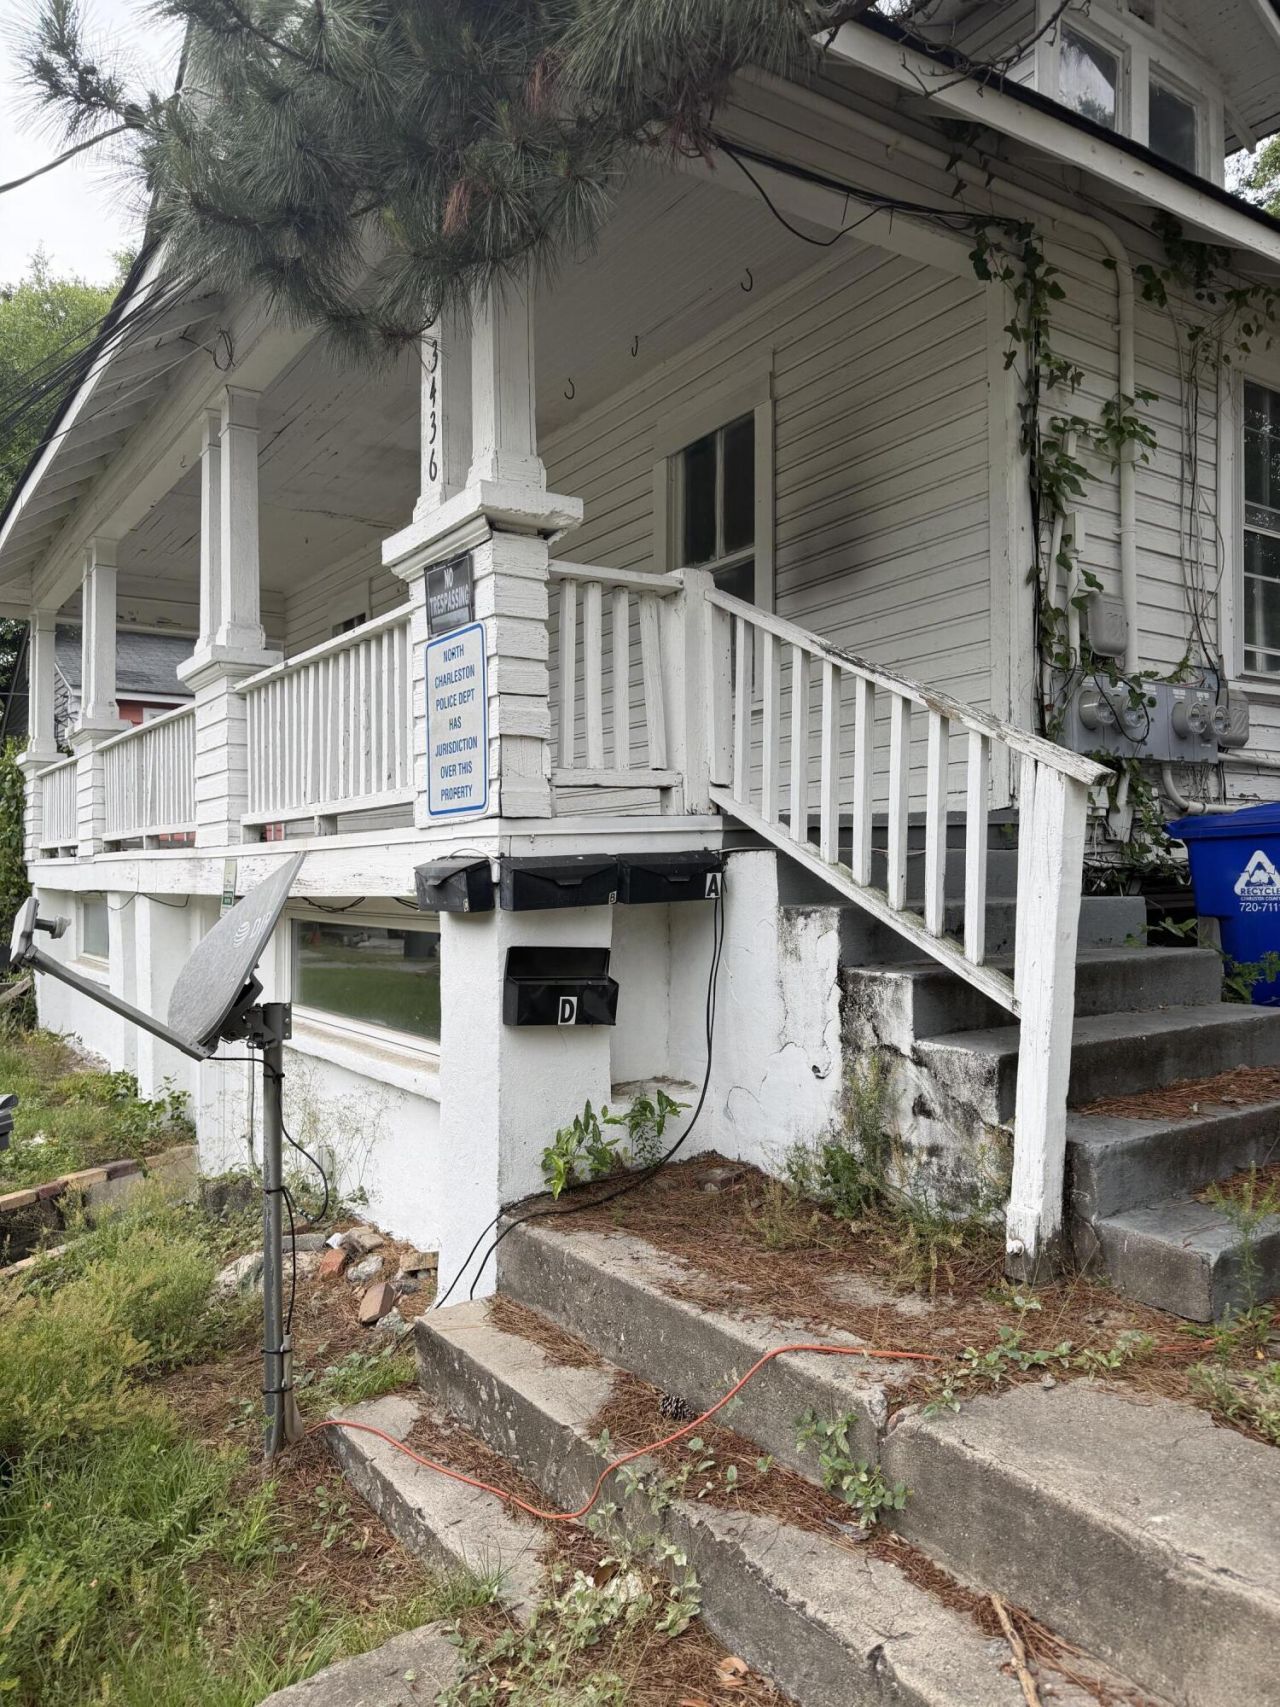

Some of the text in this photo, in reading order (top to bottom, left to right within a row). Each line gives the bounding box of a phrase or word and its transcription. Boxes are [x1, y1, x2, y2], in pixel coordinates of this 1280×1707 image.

[429, 339, 438, 482] 3436
[444, 567, 454, 589] NO
[430, 584, 470, 616] TRESPASSING
[443, 644, 465, 662] NORTH
[434, 664, 475, 689] CHARLESTON
[436, 688, 475, 711] POLICE DEPT
[449, 716, 462, 731] HAS
[435, 736, 478, 757] JURISDICTION
[440, 761, 473, 779] OVER THIS
[440, 784, 473, 801] PROPERTY
[706, 873, 720, 897] A
[1240, 887, 1280, 895] RECYCLE
[1239, 902, 1280, 912] 720-711
[559, 998, 575, 1024] D
